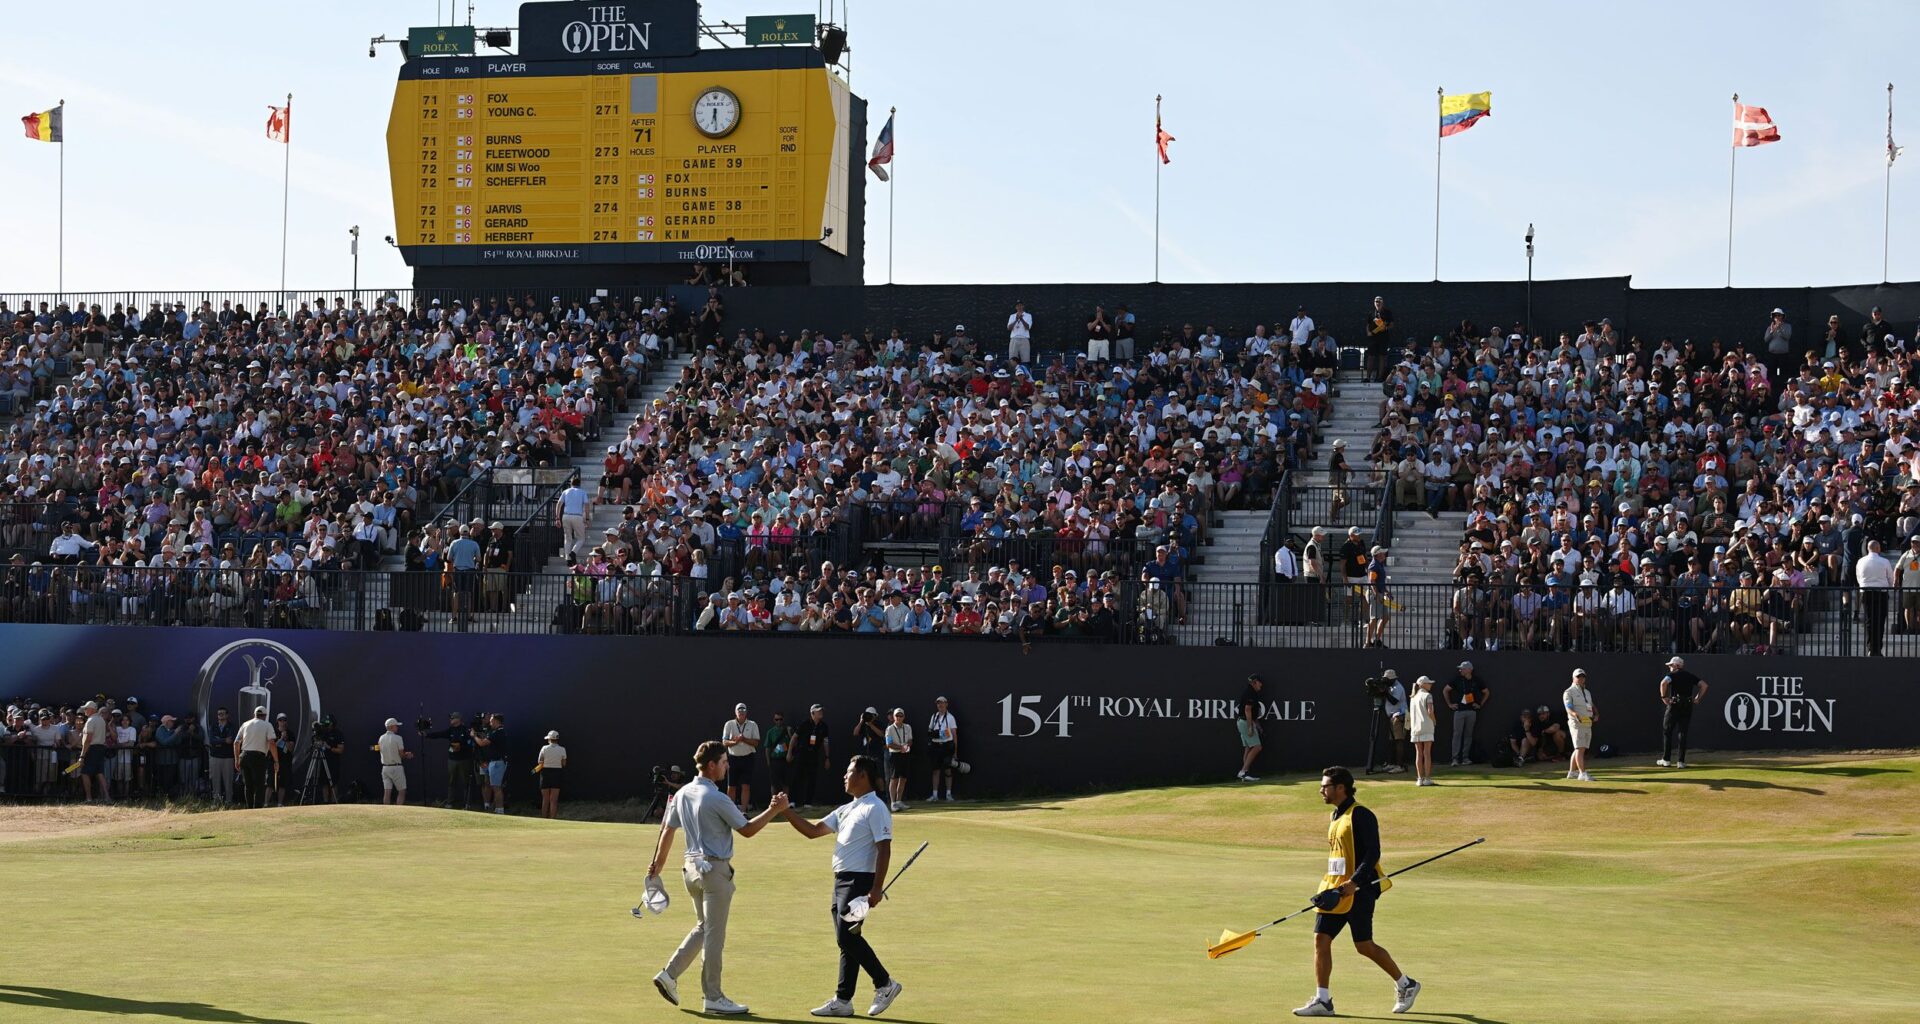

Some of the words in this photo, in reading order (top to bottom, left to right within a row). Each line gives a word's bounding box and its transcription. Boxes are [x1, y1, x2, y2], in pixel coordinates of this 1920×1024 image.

[588, 6, 626, 22] THE
[562, 20, 652, 54] OPEN
[762, 32, 798, 42] ROLEX
[424, 44, 459, 52] ROLEX
[488, 64, 526, 72] PLAYER
[423, 96, 437, 104] 71
[488, 94, 508, 103] FOX
[423, 110, 438, 118] 72
[488, 108, 524, 117] YOUNG
[526, 108, 536, 117] C.
[596, 106, 619, 115] 271
[631, 119, 656, 127] AFTER
[422, 137, 436, 146] 71
[486, 136, 522, 145] BURNS
[634, 129, 652, 143] 71
[698, 145, 736, 154] PLAYER
[780, 144, 796, 152] RND
[422, 151, 437, 160] 72
[486, 149, 550, 158] FLEETWOOD
[595, 147, 619, 157] 273
[422, 164, 437, 174] 72
[486, 164, 504, 172] KIM
[507, 163, 515, 172] Si
[518, 163, 540, 172] Woo
[683, 159, 716, 169] GAME
[726, 158, 742, 168] 39
[421, 178, 437, 188] 72
[486, 176, 546, 186] SCHEFFLER
[594, 175, 618, 185] 273
[666, 174, 690, 183] FOX
[666, 188, 707, 197] BURNS
[420, 206, 436, 215] 72
[486, 205, 522, 214] JARVIS
[594, 203, 618, 213] 274
[682, 201, 716, 211] GAME
[726, 201, 742, 210] 38
[421, 219, 435, 229] 71
[485, 218, 528, 228] GERARD
[665, 216, 715, 225] GERARD
[420, 234, 436, 243] 72
[485, 232, 534, 242] HERBERT
[593, 231, 618, 241] 274
[665, 230, 690, 239] KIM
[506, 250, 534, 258] ROYAL
[536, 250, 579, 258] BIRKDALE
[1756, 676, 1804, 696] THE
[1099, 696, 1181, 718] ROYAL
[1724, 692, 1836, 732] OPEN
